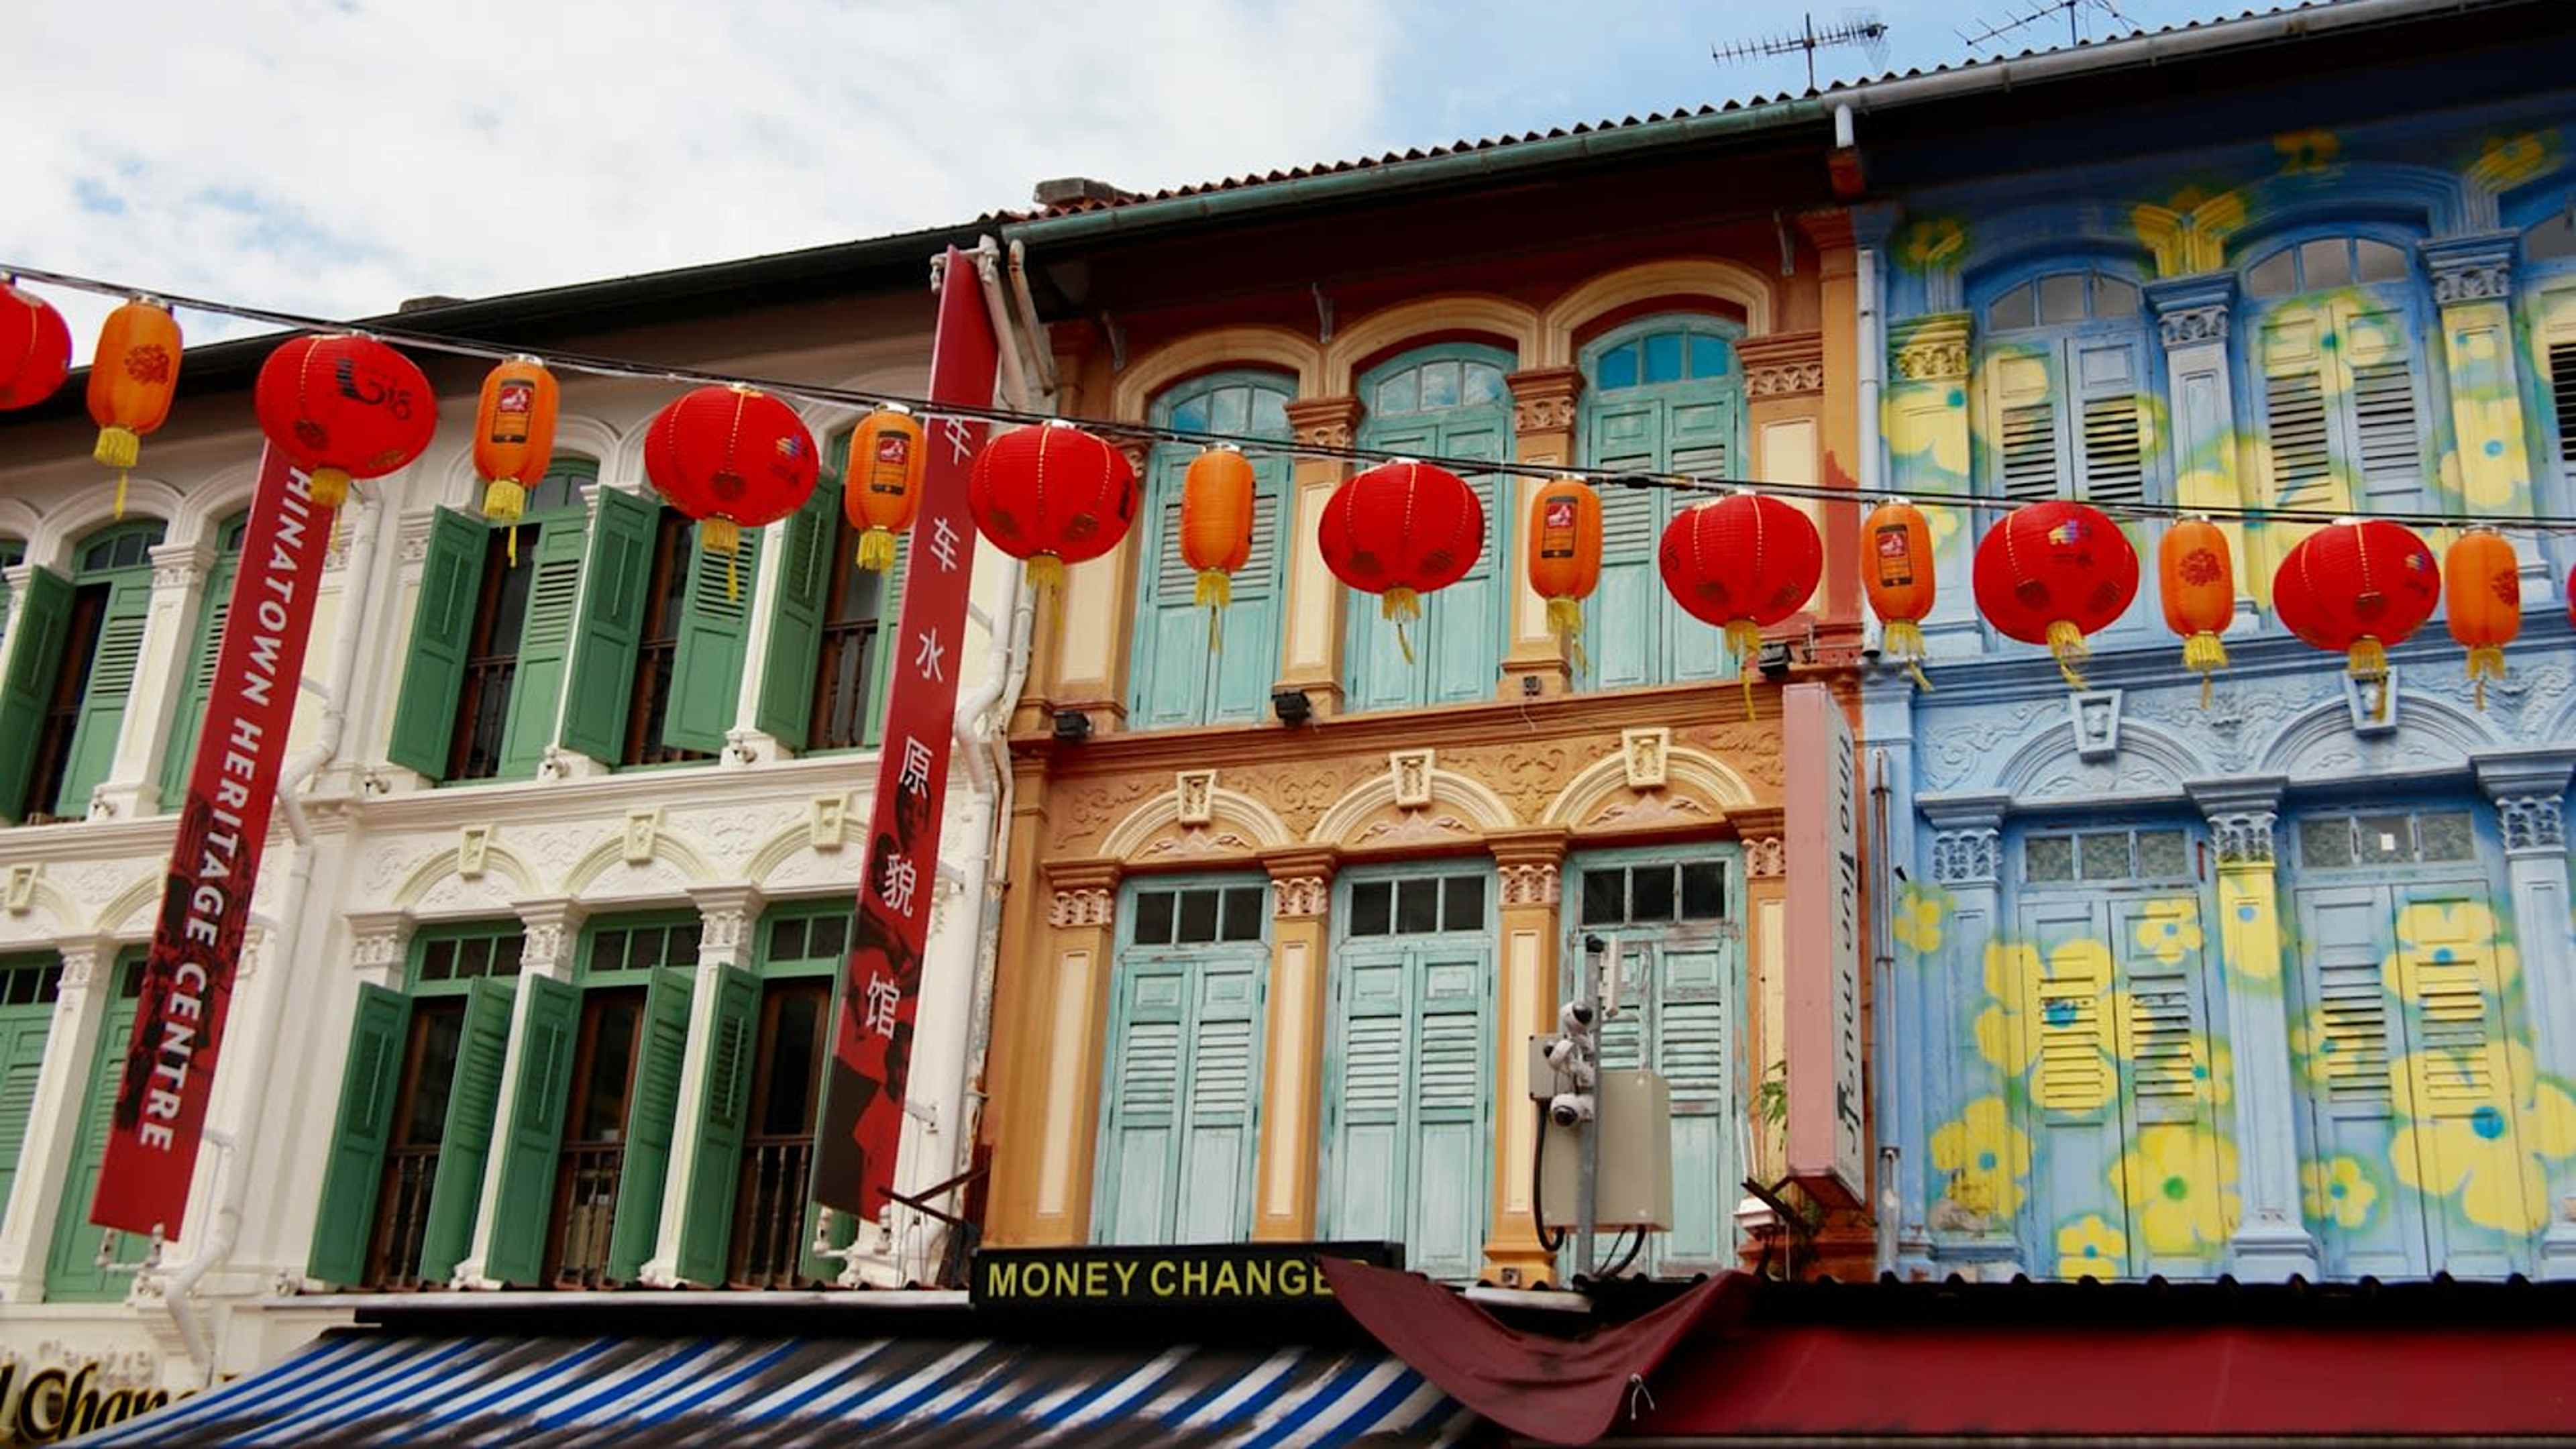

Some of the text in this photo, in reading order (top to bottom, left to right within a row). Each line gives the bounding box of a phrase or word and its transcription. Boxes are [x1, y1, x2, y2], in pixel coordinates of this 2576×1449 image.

[140, 466, 313, 1152] HINATOWN HERITAGE CENTRE
[987, 1258, 1368, 1297] MONEY CHANGE
[19, 1361, 199, 1442] Cha
